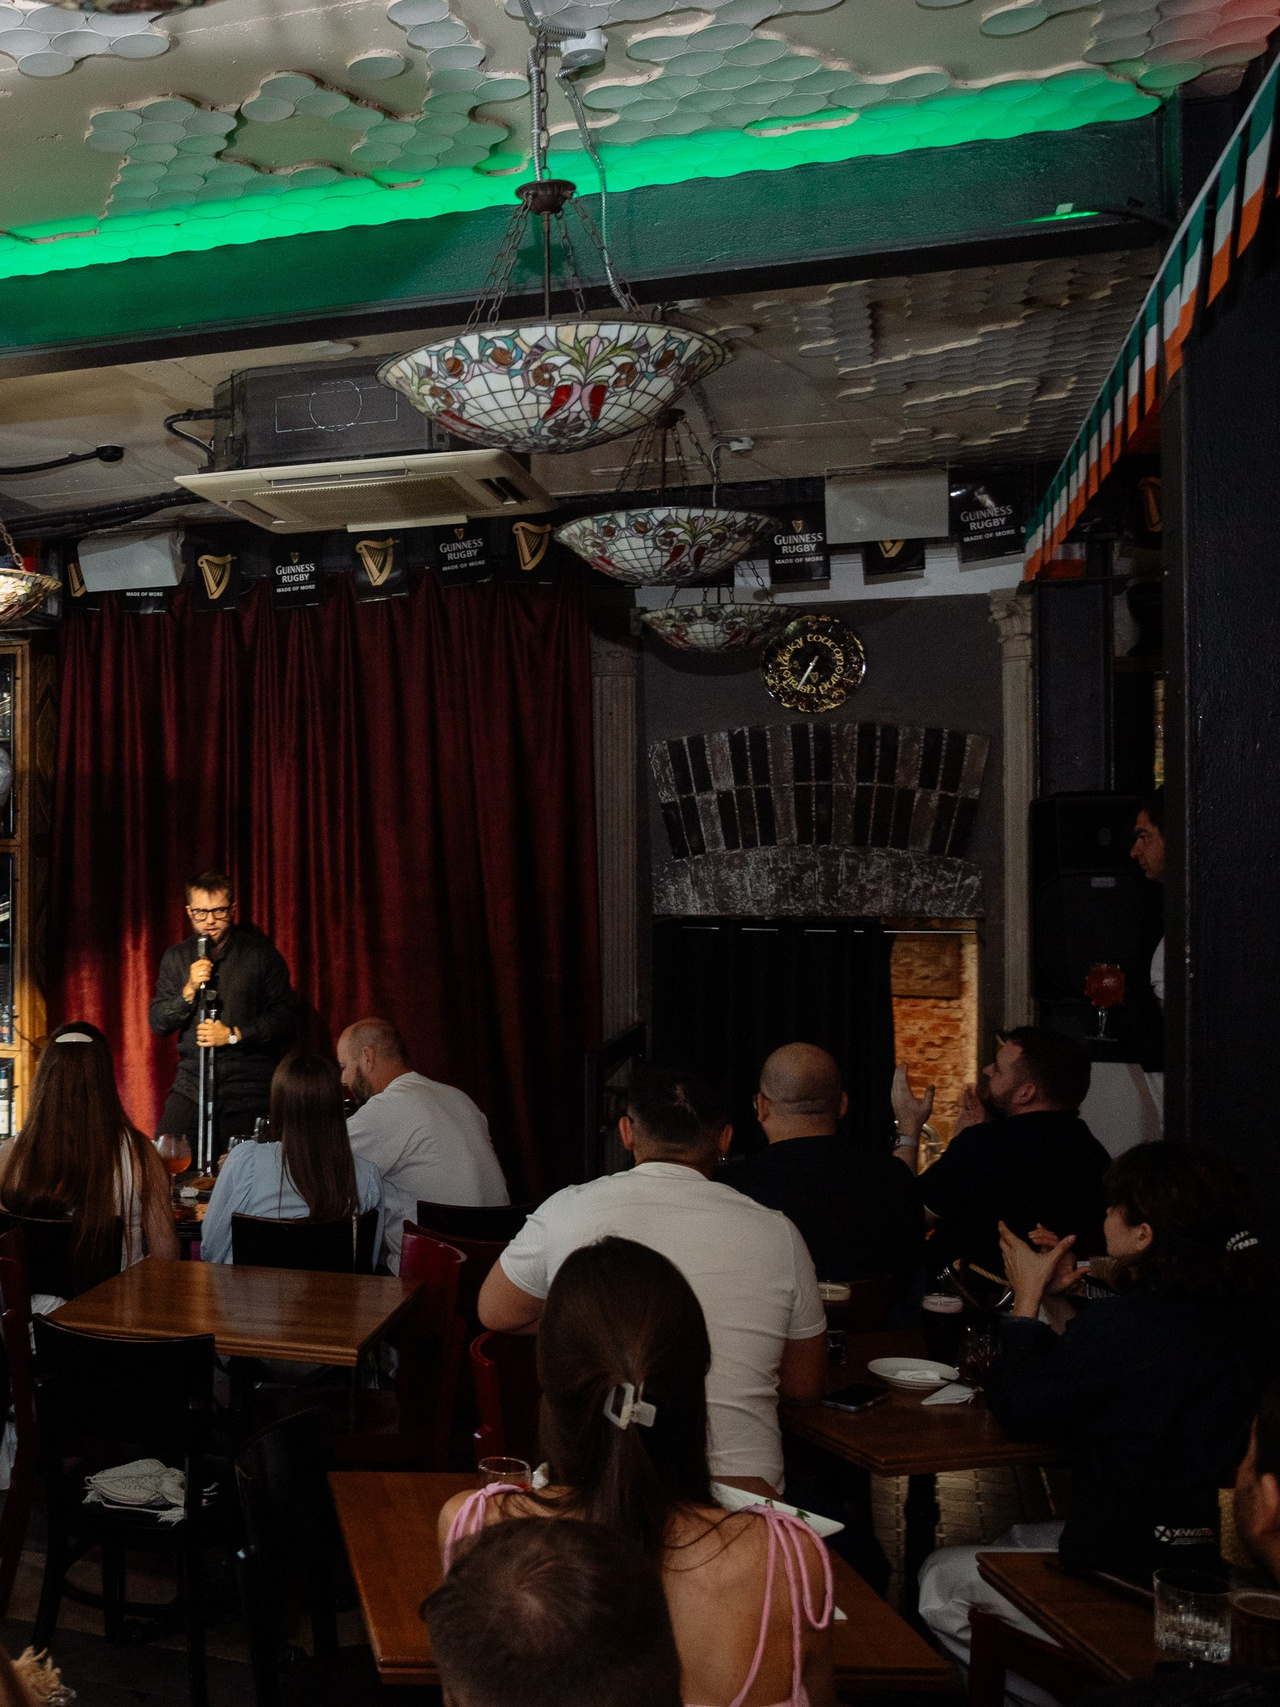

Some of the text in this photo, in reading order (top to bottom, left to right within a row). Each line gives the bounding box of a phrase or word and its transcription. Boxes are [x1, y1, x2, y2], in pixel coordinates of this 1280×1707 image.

[960, 505, 1013, 522] GUINNESS
[970, 517, 1006, 530] RUGBY
[774, 532, 823, 545] GUINNESS
[995, 529, 1015, 537] MORE
[440, 538, 483, 553] GUINNESS
[782, 544, 816, 553] RUGBY
[447, 549, 477, 560] RUGBY
[275, 563, 316, 576] GUINNESS
[282, 573, 310, 583] RUGBY
